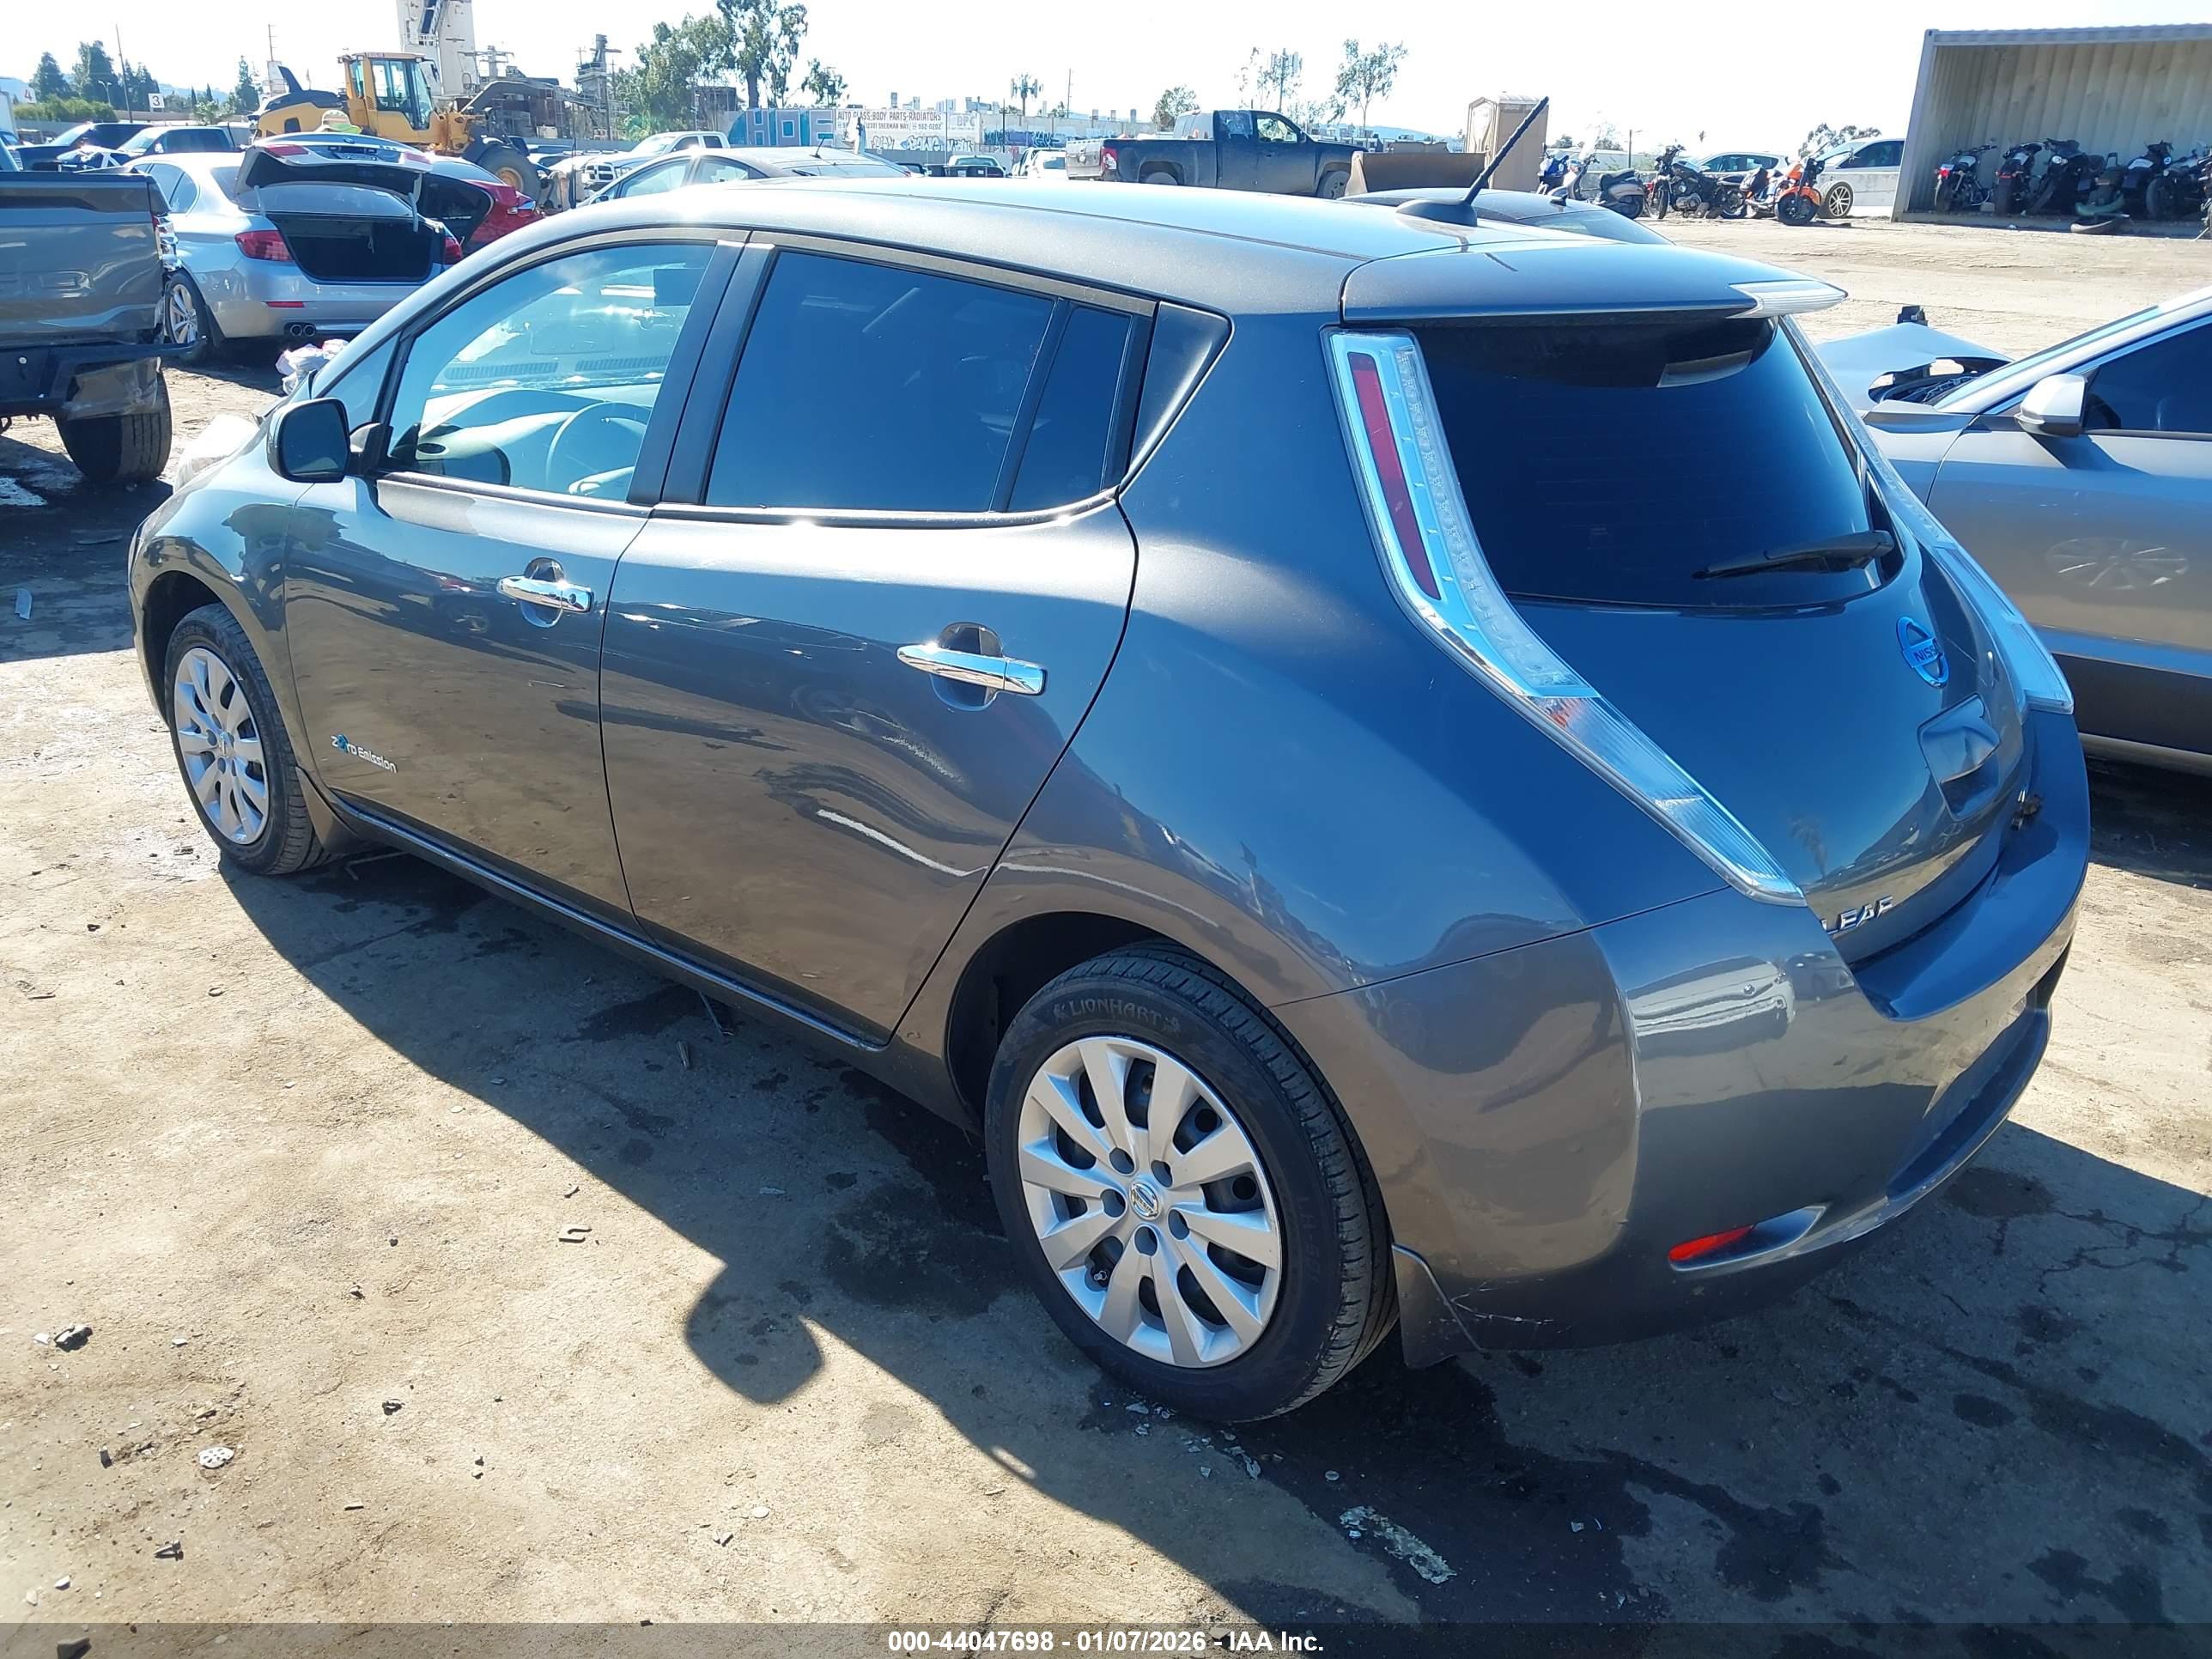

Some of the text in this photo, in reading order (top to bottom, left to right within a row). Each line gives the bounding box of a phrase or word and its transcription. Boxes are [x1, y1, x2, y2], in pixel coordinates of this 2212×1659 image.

[24, 89, 33, 100] 4
[153, 95, 161, 106] 3
[357, 746, 398, 775] Emission
[1820, 894, 1893, 935] LEAF
[1069, 998, 1163, 1025] LIONHART
